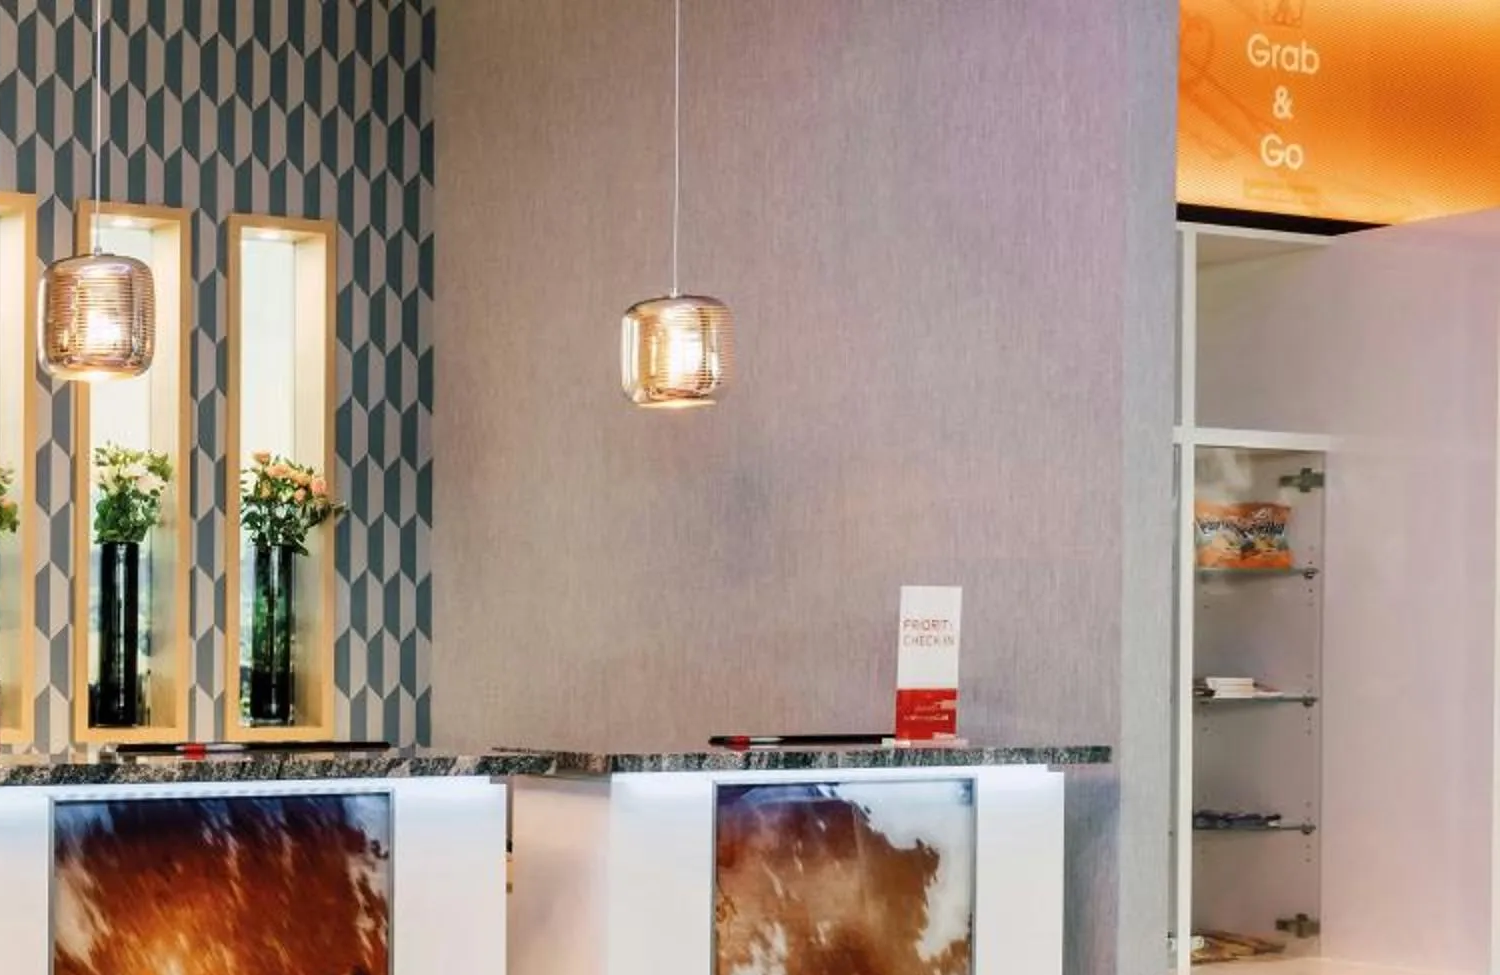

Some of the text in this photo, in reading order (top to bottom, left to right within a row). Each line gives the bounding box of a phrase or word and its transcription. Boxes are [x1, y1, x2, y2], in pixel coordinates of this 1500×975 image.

[1247, 33, 1320, 74] Grab
[1272, 85, 1294, 119] &
[1260, 133, 1304, 170] Go
